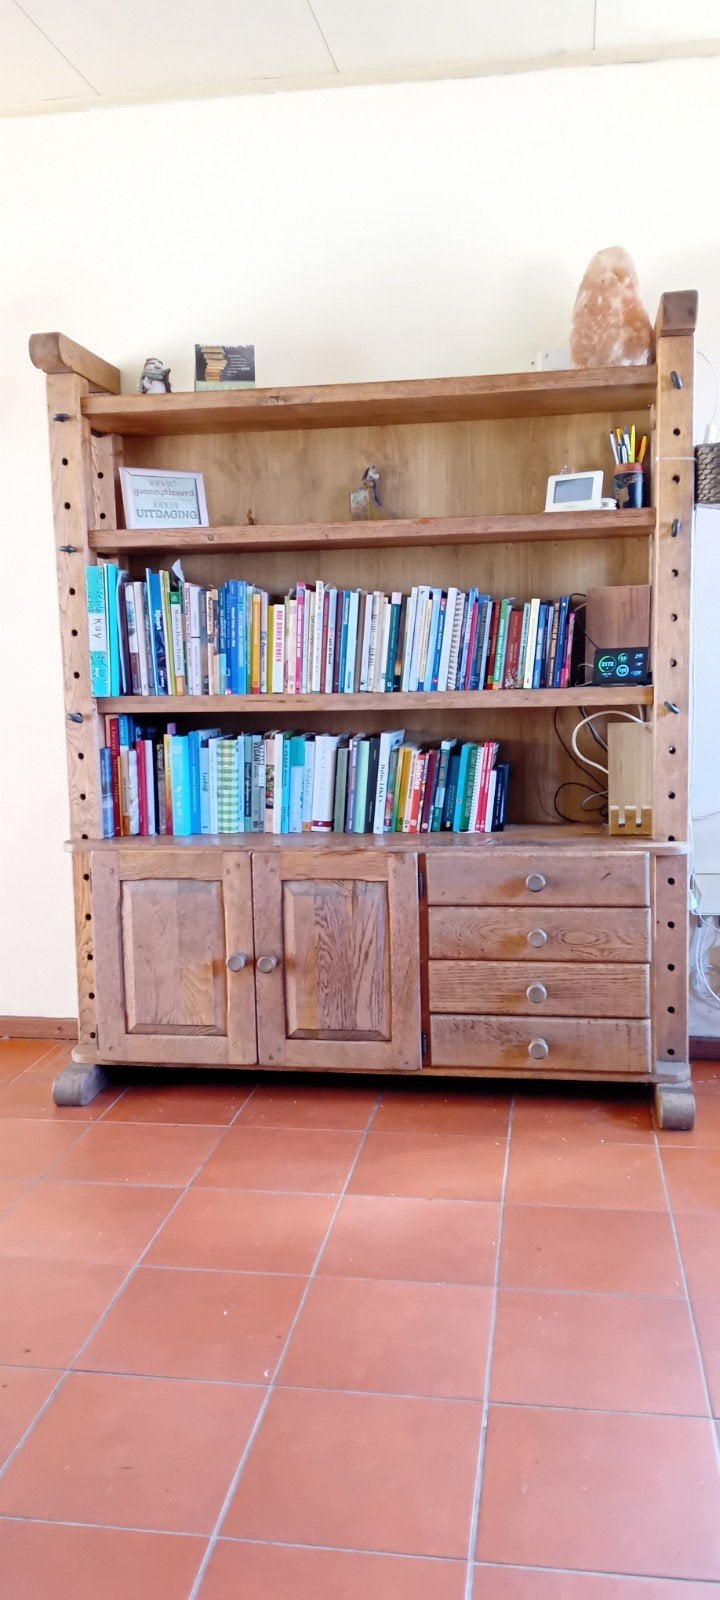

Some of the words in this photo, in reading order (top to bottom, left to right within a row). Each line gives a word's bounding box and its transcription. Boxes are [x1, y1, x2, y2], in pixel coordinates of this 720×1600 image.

[134, 488, 195, 497] gecompliceerd
[136, 509, 197, 519] UITDAGING
[93, 618, 102, 639] Kay
